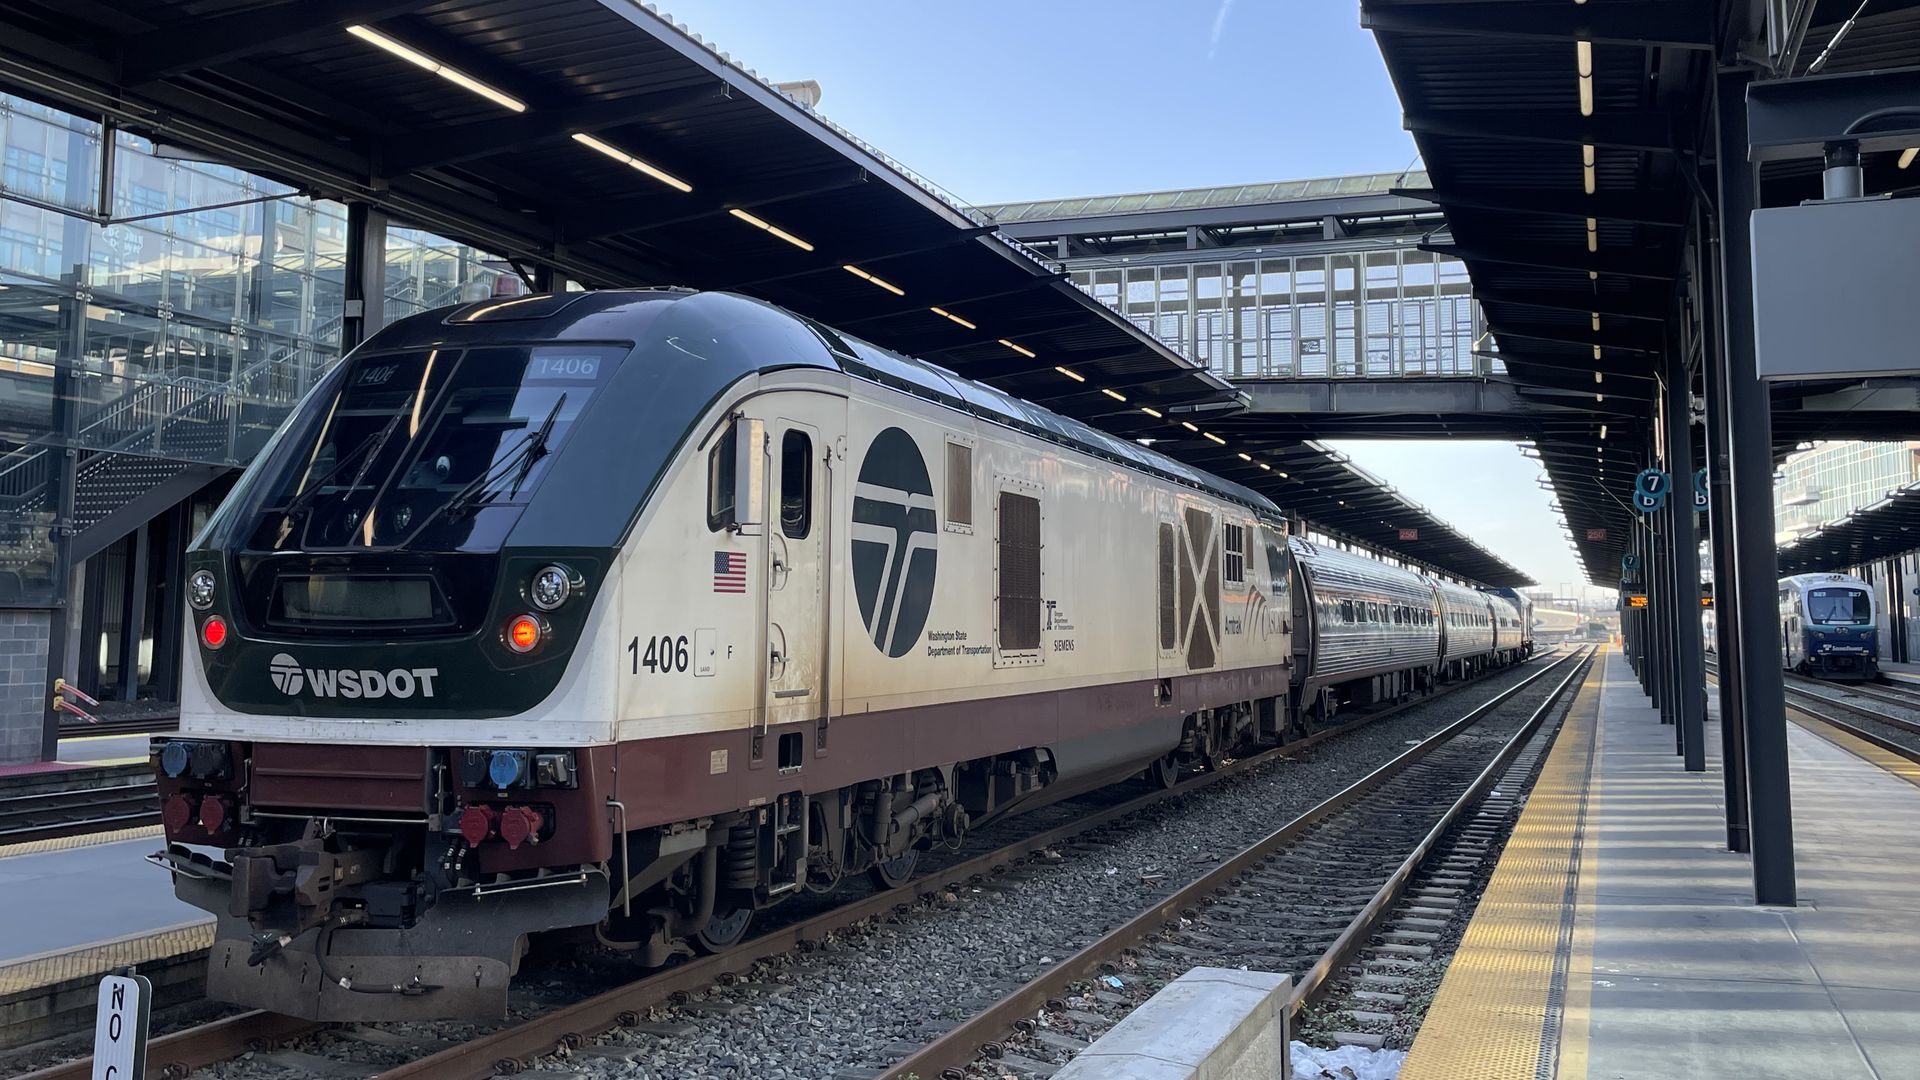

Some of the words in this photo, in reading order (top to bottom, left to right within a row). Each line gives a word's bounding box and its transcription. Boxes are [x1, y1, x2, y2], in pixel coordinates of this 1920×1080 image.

[540, 358, 595, 375] 1406
[1648, 476, 1659, 491] 7
[1627, 556, 1634, 565] 7
[1225, 615, 1243, 635] Amtrak
[927, 630, 955, 643] Washington
[955, 630, 968, 641] State
[727, 645, 733, 659] F
[927, 645, 956, 658] Department
[962, 645, 992, 656] Transportation
[1054, 639, 1075, 652] SIEMENS
[628, 635, 689, 675] 1406
[305, 667, 439, 699] WSDOT
[109, 982, 125, 1043] NO
